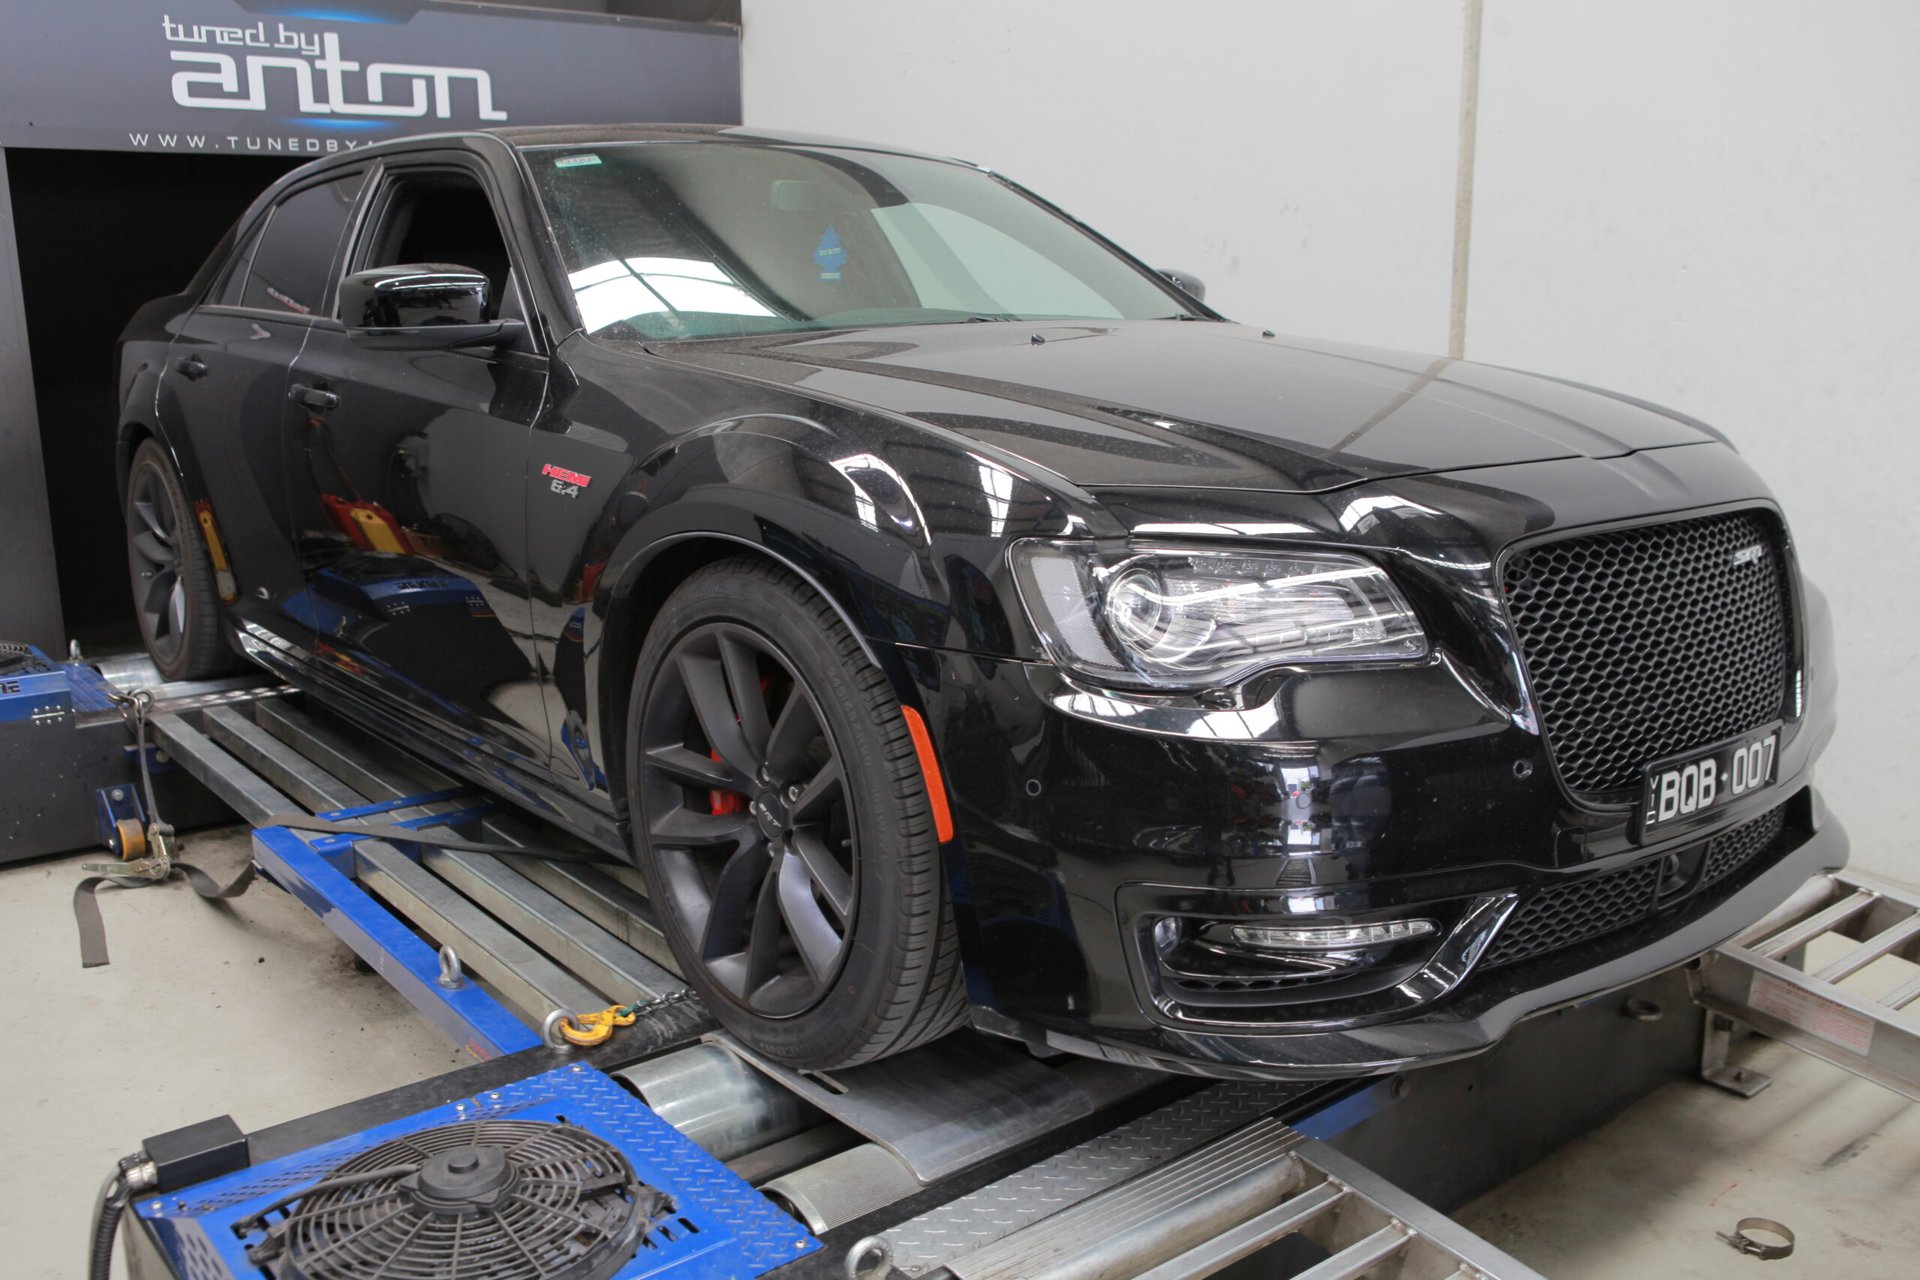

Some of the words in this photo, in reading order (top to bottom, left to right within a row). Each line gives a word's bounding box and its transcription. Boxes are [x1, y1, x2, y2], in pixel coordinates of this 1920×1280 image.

[162, 14, 271, 47] tuned
[273, 22, 320, 56] by
[170, 31, 508, 121] anton
[128, 132, 373, 153] WWW.TUNEDBY
[541, 463, 592, 488] HEMI
